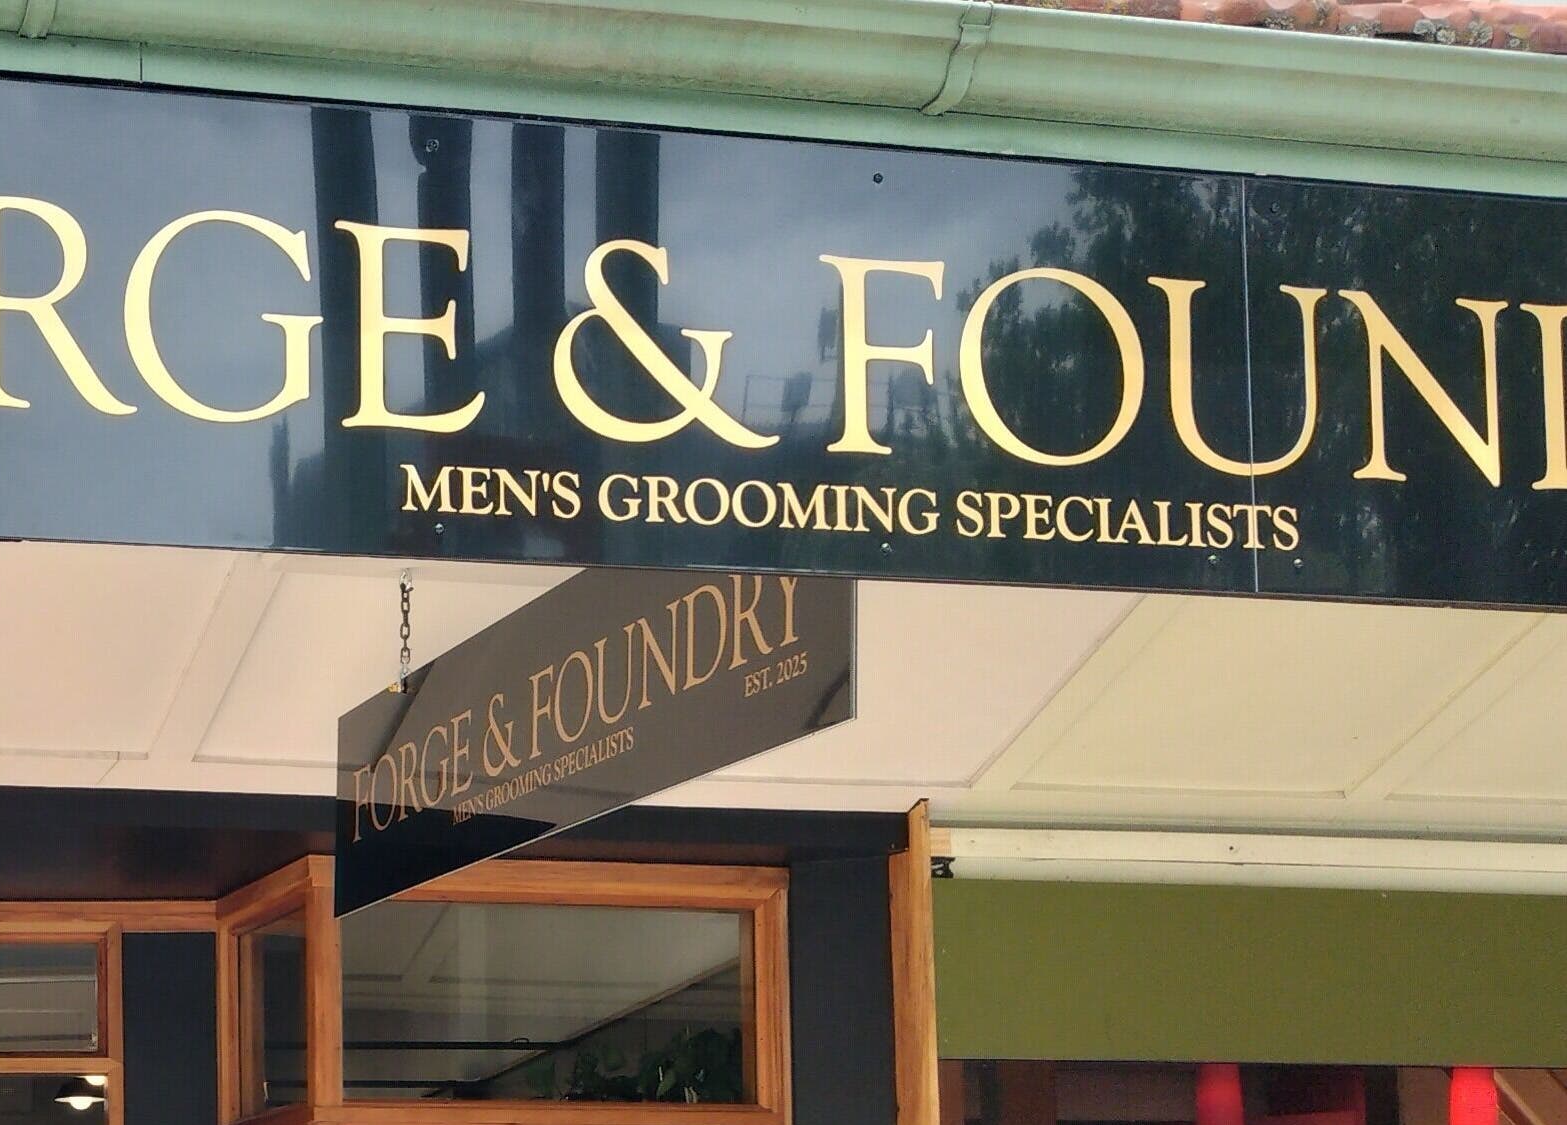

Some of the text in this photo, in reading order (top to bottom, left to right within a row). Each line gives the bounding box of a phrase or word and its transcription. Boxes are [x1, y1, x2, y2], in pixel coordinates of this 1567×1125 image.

[552, 238, 782, 449] &
[399, 463, 1301, 551] MEN'S GROOMING SPECIALISTS
[351, 573, 801, 844] FORGE & FOUNDRY
[743, 650, 809, 698] EST. 2025
[484, 766, 552, 811] GROOMING
[553, 725, 635, 781] SPECIALISTS
